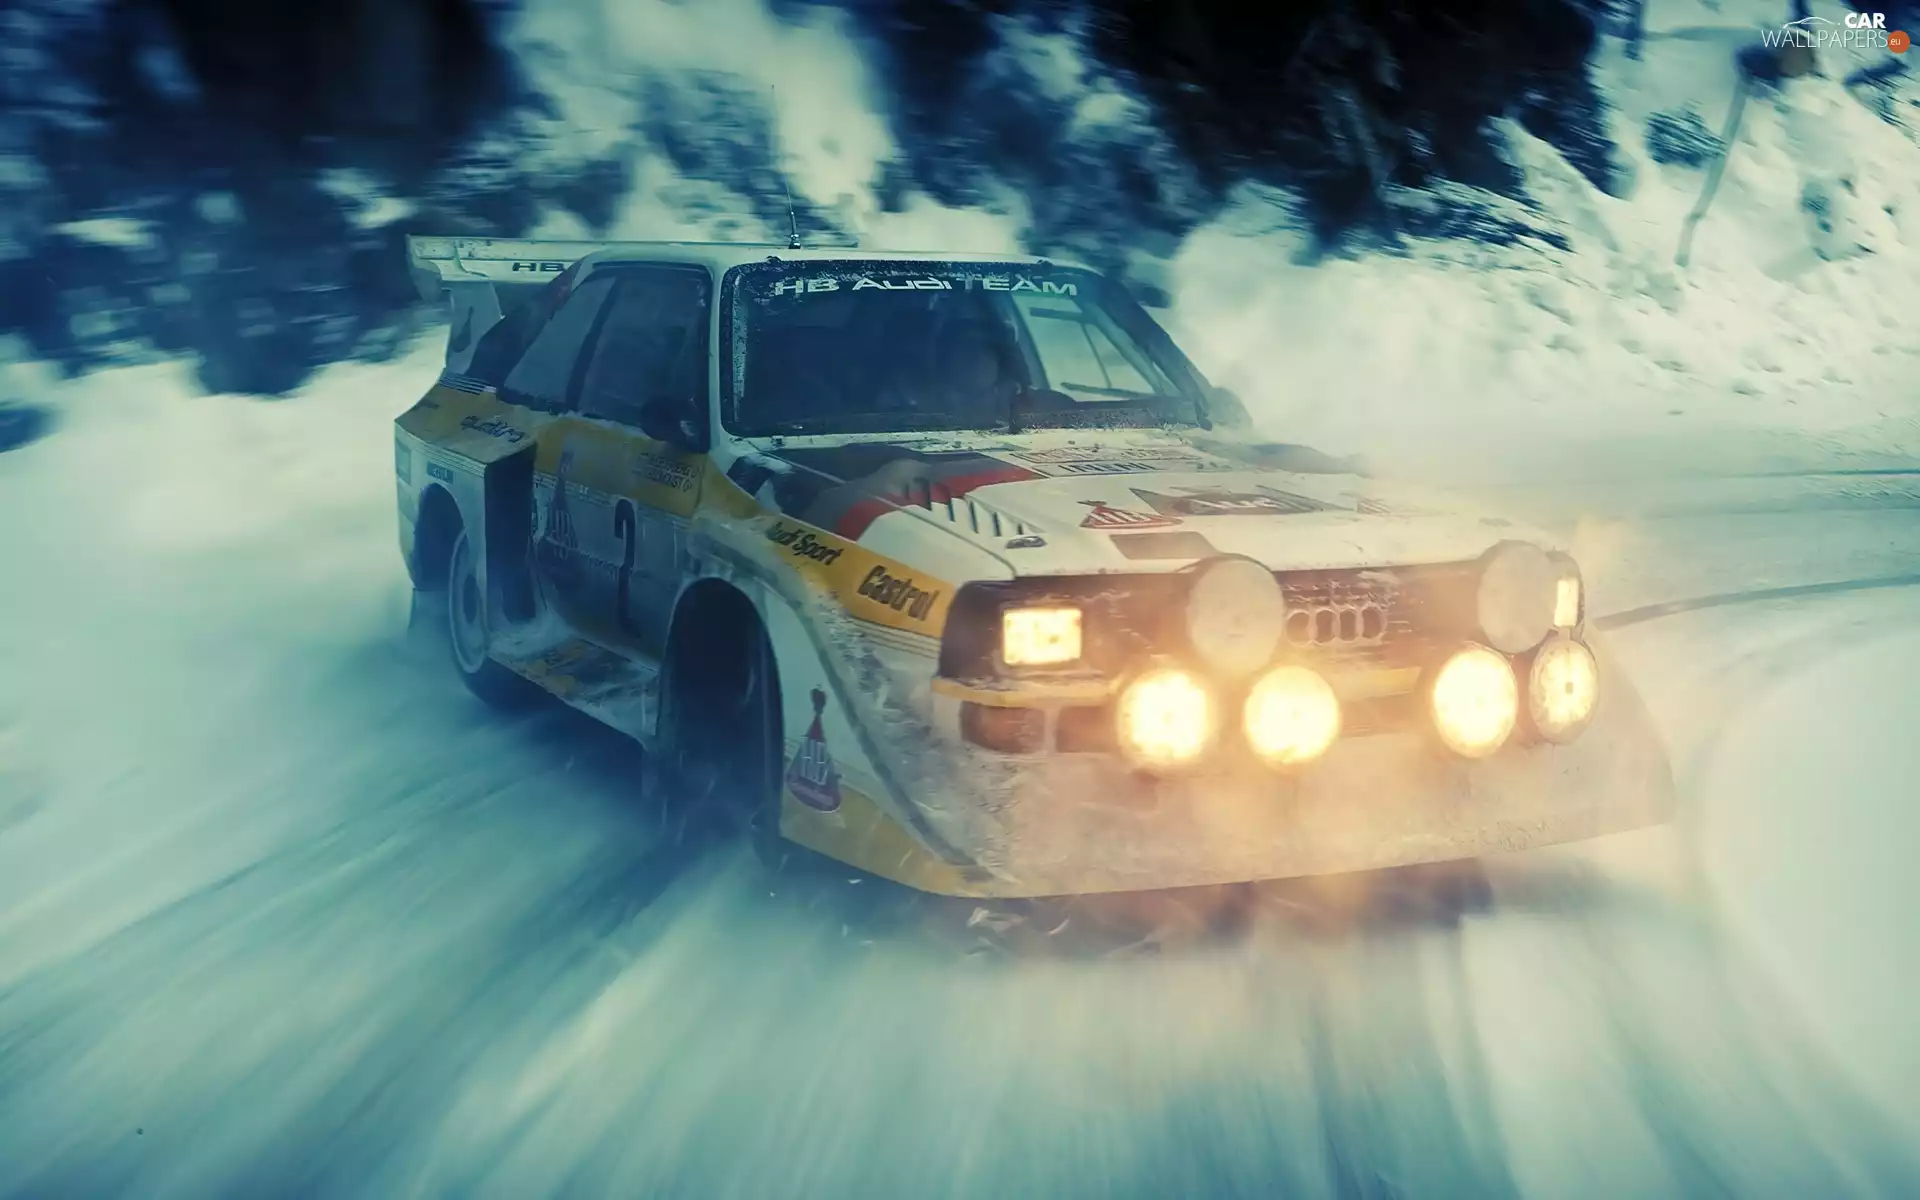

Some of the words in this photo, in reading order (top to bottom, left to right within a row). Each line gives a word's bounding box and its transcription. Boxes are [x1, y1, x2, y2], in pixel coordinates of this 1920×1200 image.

[774, 277, 840, 296] HB
[957, 276, 1077, 296] TEAM
[792, 534, 844, 566] Sport
[857, 564, 941, 622] Castrol
